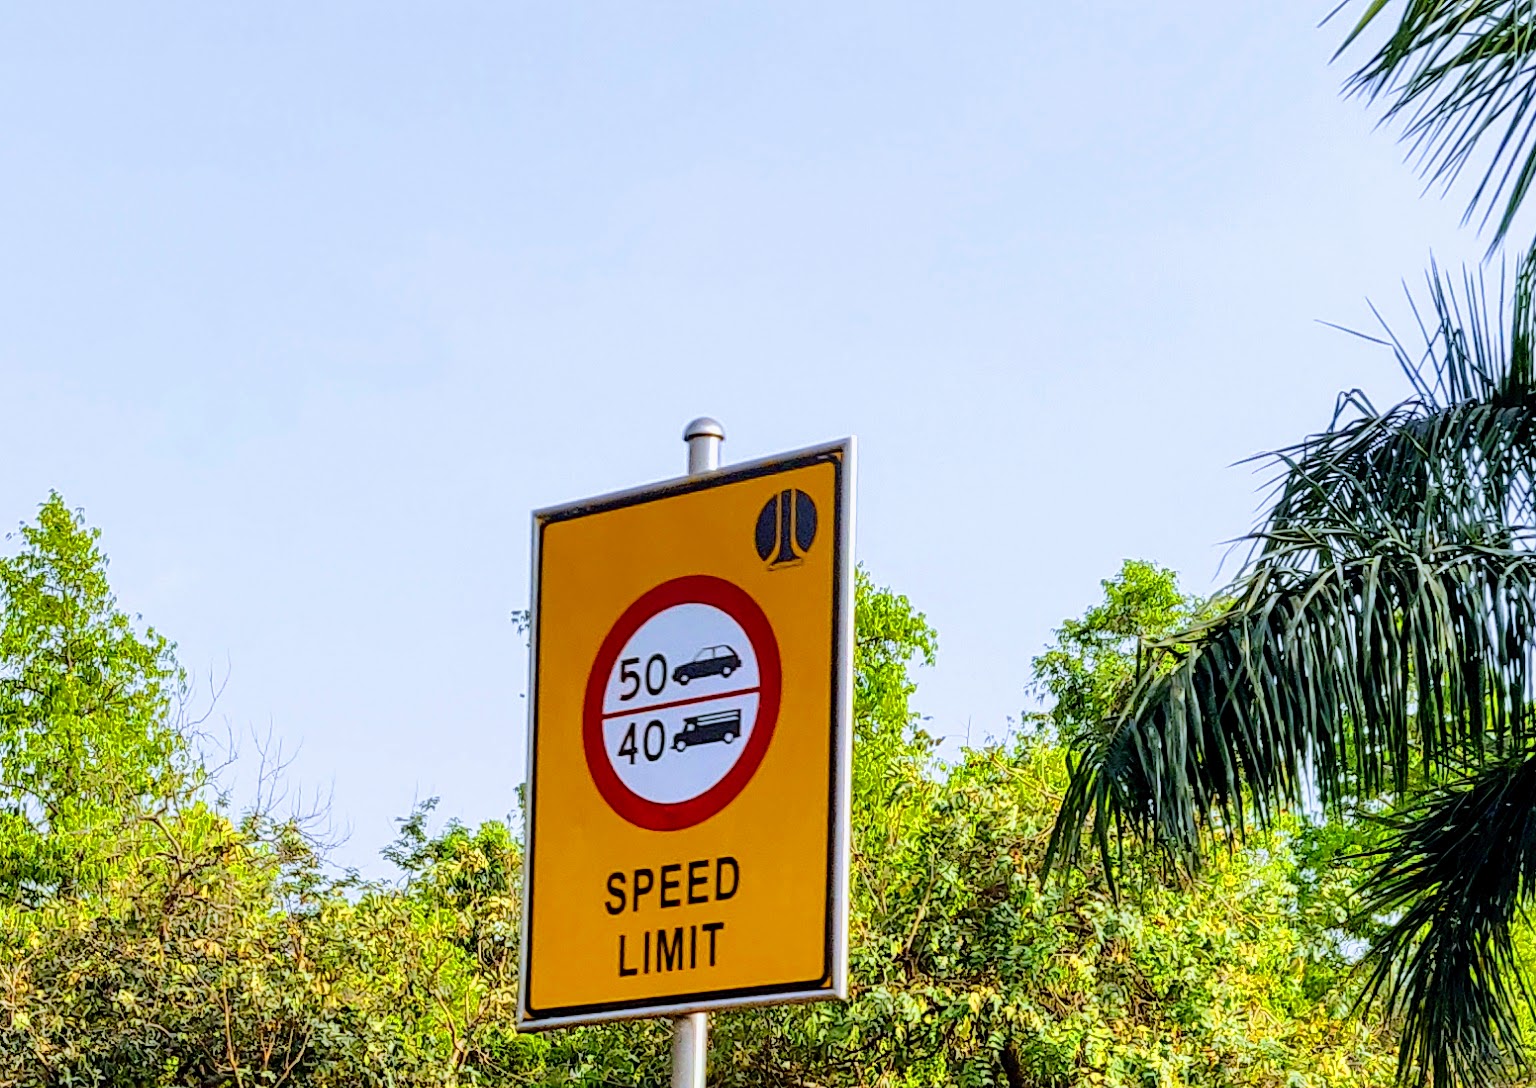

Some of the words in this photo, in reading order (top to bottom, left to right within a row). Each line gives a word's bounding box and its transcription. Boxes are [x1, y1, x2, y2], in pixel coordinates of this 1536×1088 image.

[619, 653, 667, 701] 50
[617, 719, 665, 765] 40
[605, 856, 740, 916] SPEED
[619, 922, 724, 977] LIMIT
